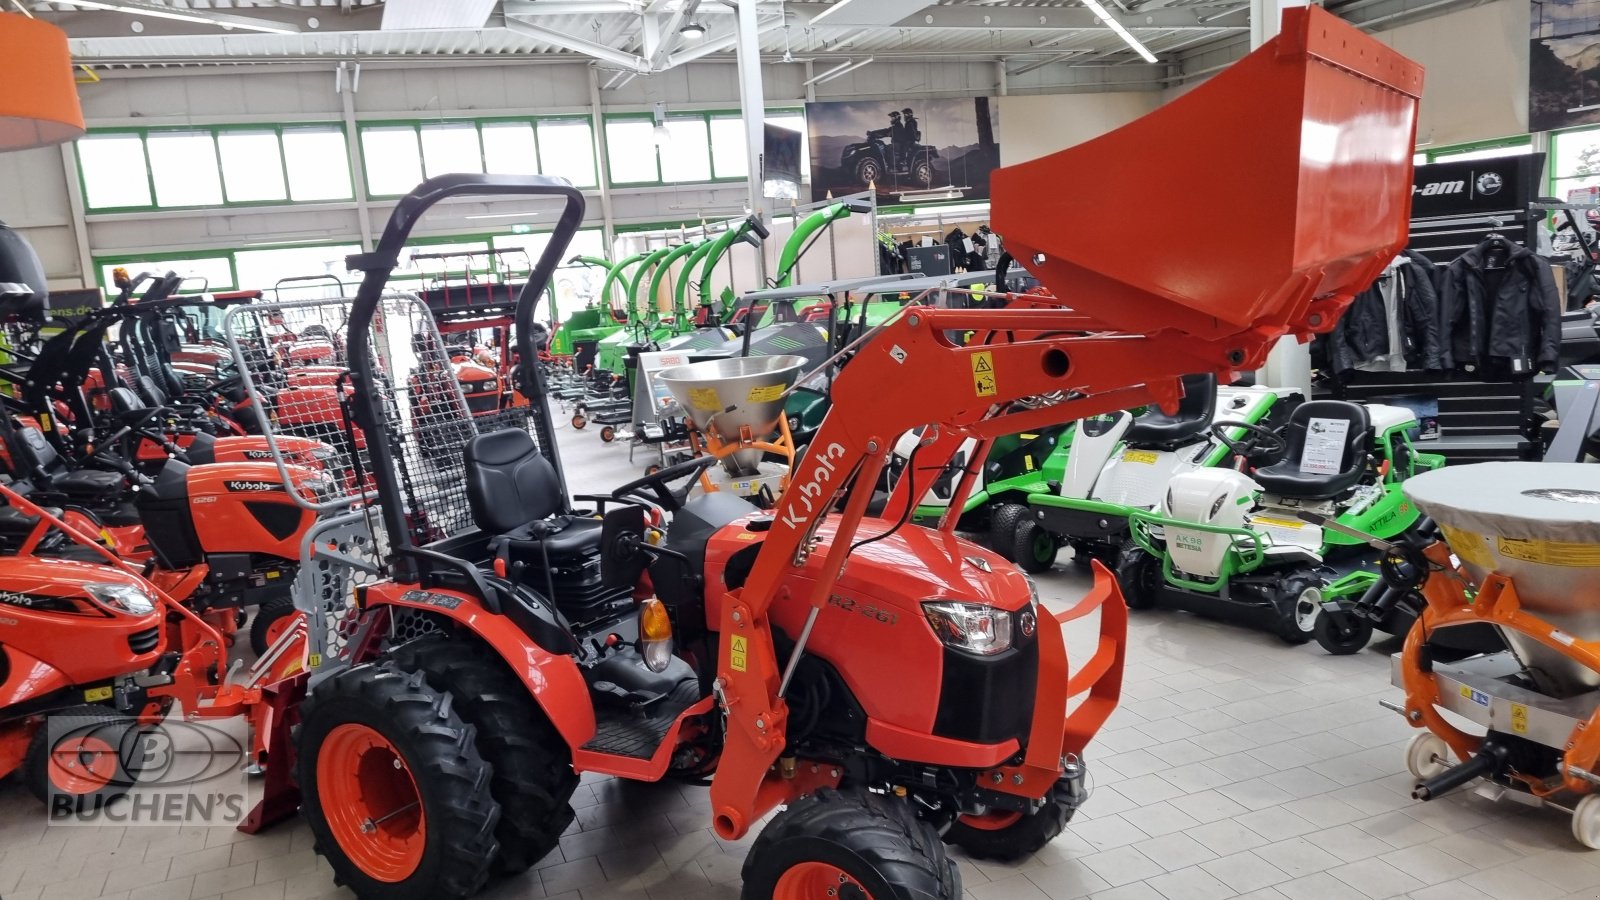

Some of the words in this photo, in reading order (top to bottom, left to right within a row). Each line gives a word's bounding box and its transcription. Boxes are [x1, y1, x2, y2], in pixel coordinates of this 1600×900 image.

[249, 451, 273, 459] Kubo
[231, 481, 271, 491] Kubota
[782, 442, 846, 530] Kubota
[1369, 511, 1397, 533] ATTILA
[0, 591, 32, 606] bota
